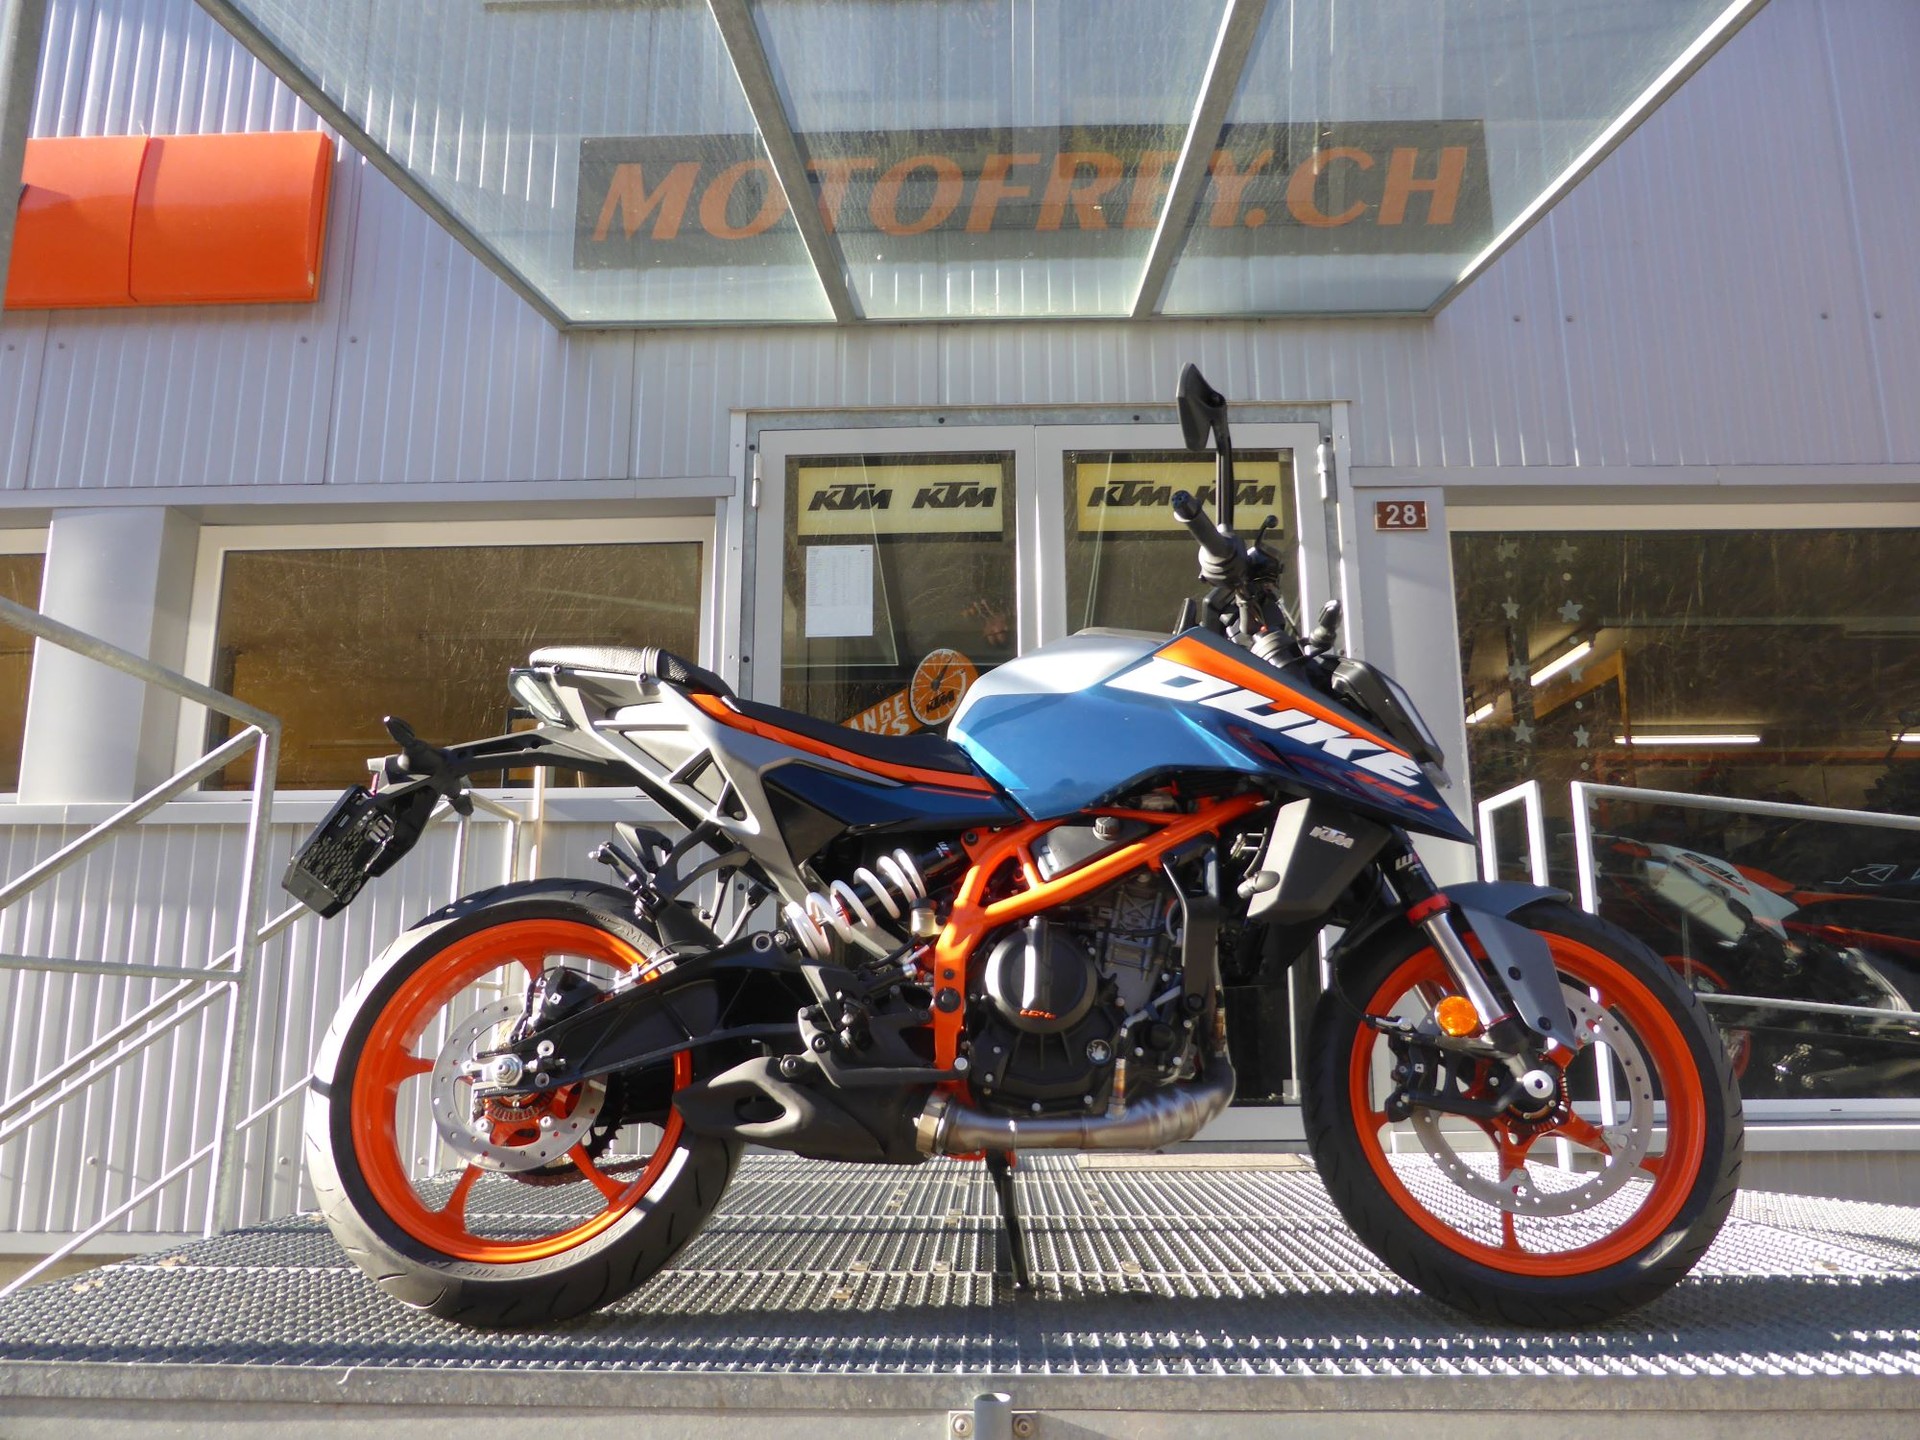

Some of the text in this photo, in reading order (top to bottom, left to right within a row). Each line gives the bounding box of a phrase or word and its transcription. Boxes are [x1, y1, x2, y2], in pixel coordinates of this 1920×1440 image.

[807, 481, 997, 511] KTM KTM
[1087, 480, 1172, 507] KTM
[1385, 504, 1418, 525] 28
[926, 690, 955, 713] KTM
[1104, 656, 1422, 787] DUKE
[1308, 825, 1355, 849] KTM
